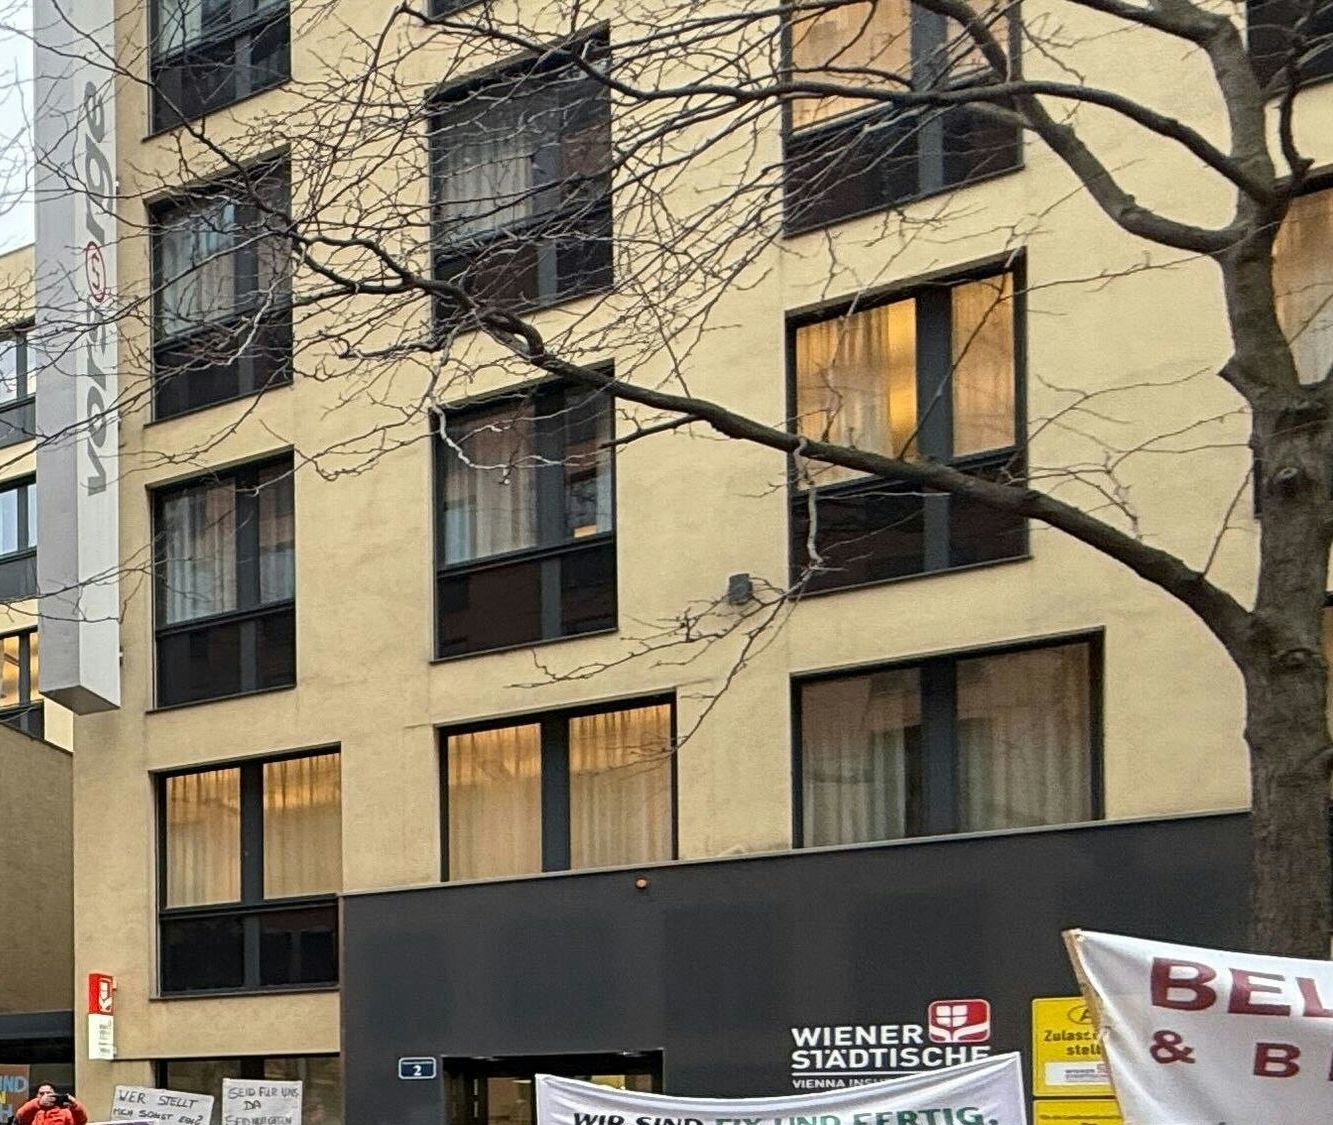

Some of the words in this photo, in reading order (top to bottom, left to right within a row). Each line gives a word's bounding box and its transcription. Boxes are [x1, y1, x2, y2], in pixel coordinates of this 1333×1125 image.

[791, 1024, 924, 1047] WIENER
[1149, 1030, 1195, 1064] &
[412, 1065, 423, 1076] 2
[792, 1079, 846, 1090] VIENNA
[119, 1090, 147, 1104] WER
[158, 1095, 200, 1109] STELLT
[228, 1086, 256, 1100] SEID
[243, 1099, 262, 1111] DA
